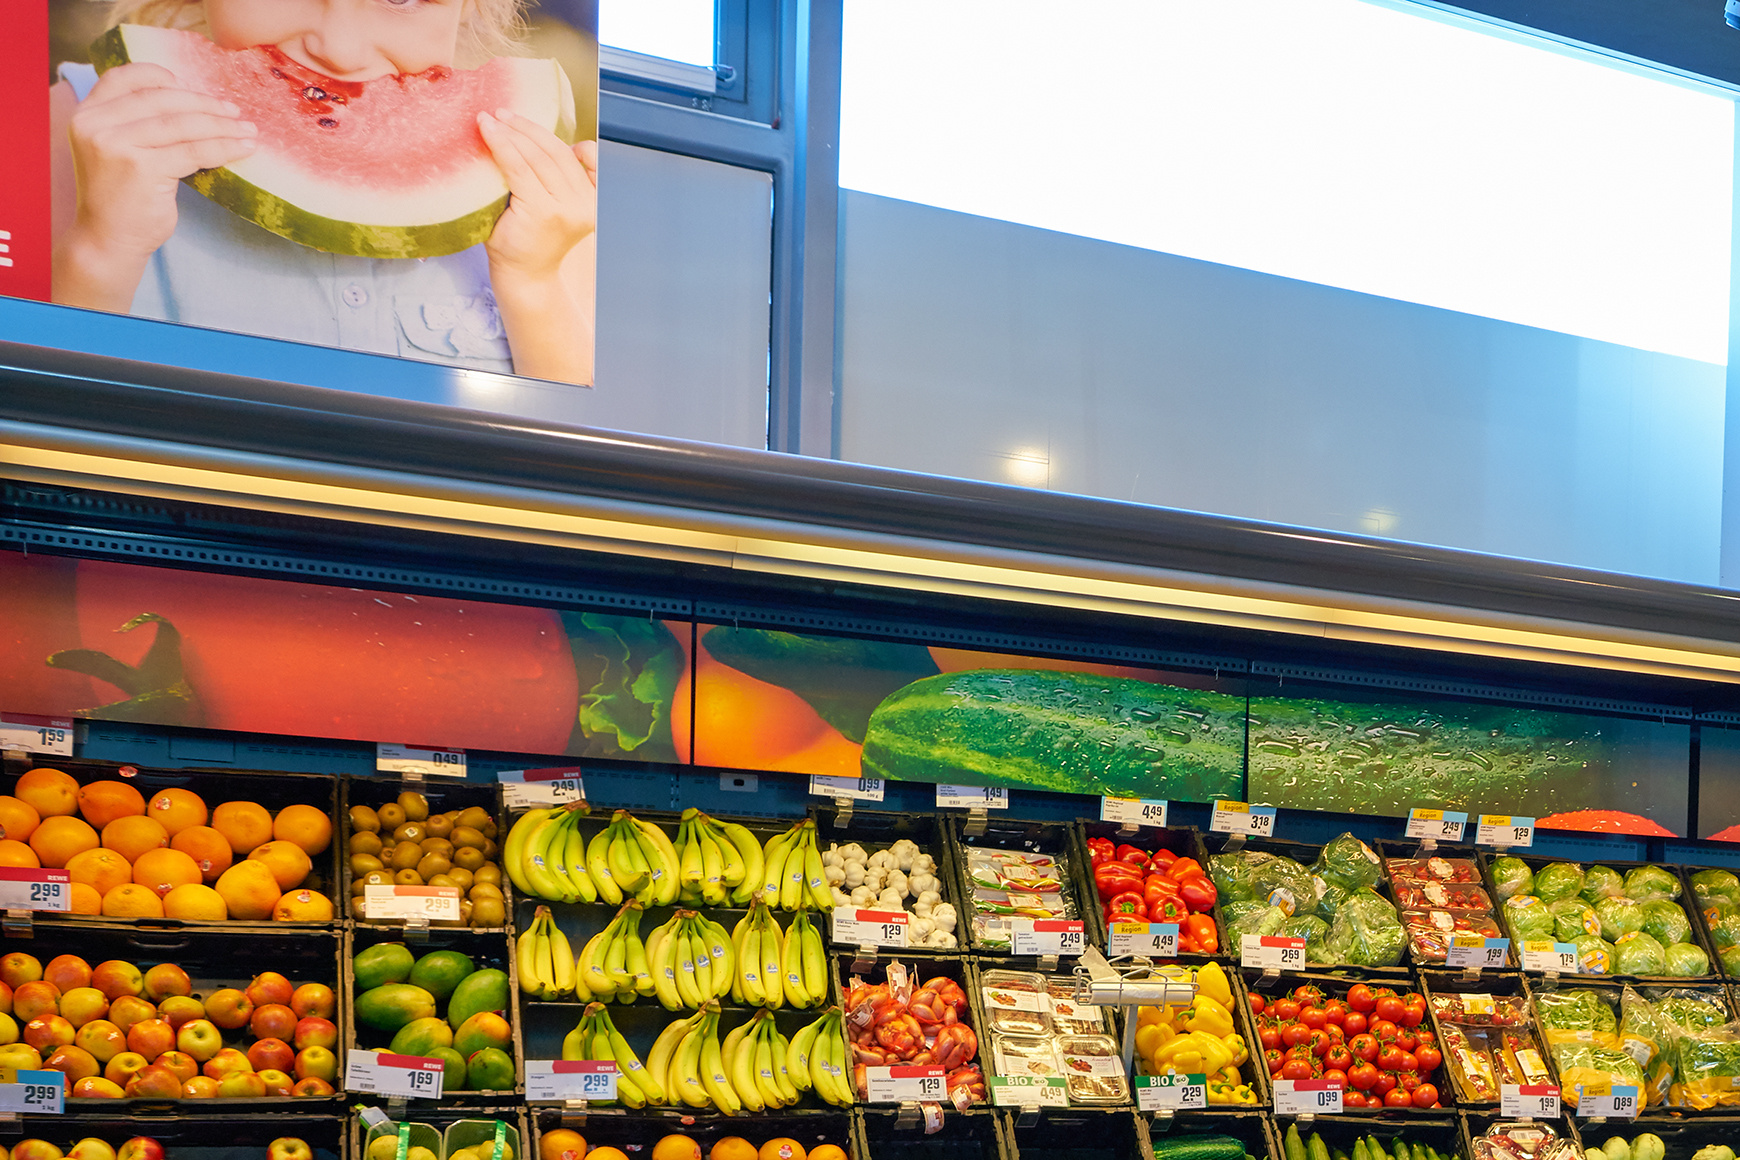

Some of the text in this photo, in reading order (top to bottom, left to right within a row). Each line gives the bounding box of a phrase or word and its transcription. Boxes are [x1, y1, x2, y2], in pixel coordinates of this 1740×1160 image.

[38, 728, 65, 746] 1.59
[433, 753, 458, 767] 0.49
[551, 780, 575, 797] 2.49
[858, 778, 880, 792] 0.99
[983, 787, 1002, 801] 1.49
[1142, 806, 1162, 819] 4.49
[1251, 816, 1269, 829] 3.18
[1442, 822, 1459, 834] 2.49
[1514, 828, 1529, 840] 1.29
[31, 884, 60, 901] 2.99
[882, 924, 901, 939] 1.29
[1121, 926, 1142, 934] Region
[1061, 934, 1080, 947] 2.49
[1153, 935, 1173, 949] 4.49
[1282, 949, 1300, 963] 2.69
[1487, 949, 1502, 961] 1.99
[1560, 953, 1574, 966] 1.79
[408, 1071, 433, 1088] 1.69
[584, 1075, 608, 1091] 2.99
[919, 1078, 940, 1094] 1.29
[1007, 1077, 1028, 1086] BIO
[1150, 1076, 1170, 1086] BIO
[24, 1086, 56, 1104] 2.99
[1041, 1088, 1062, 1100] 4.49
[1182, 1087, 1201, 1101] 2.29
[1318, 1092, 1337, 1106] 0.99
[1540, 1097, 1554, 1110] 1.99
[1614, 1098, 1632, 1110] 0.89
